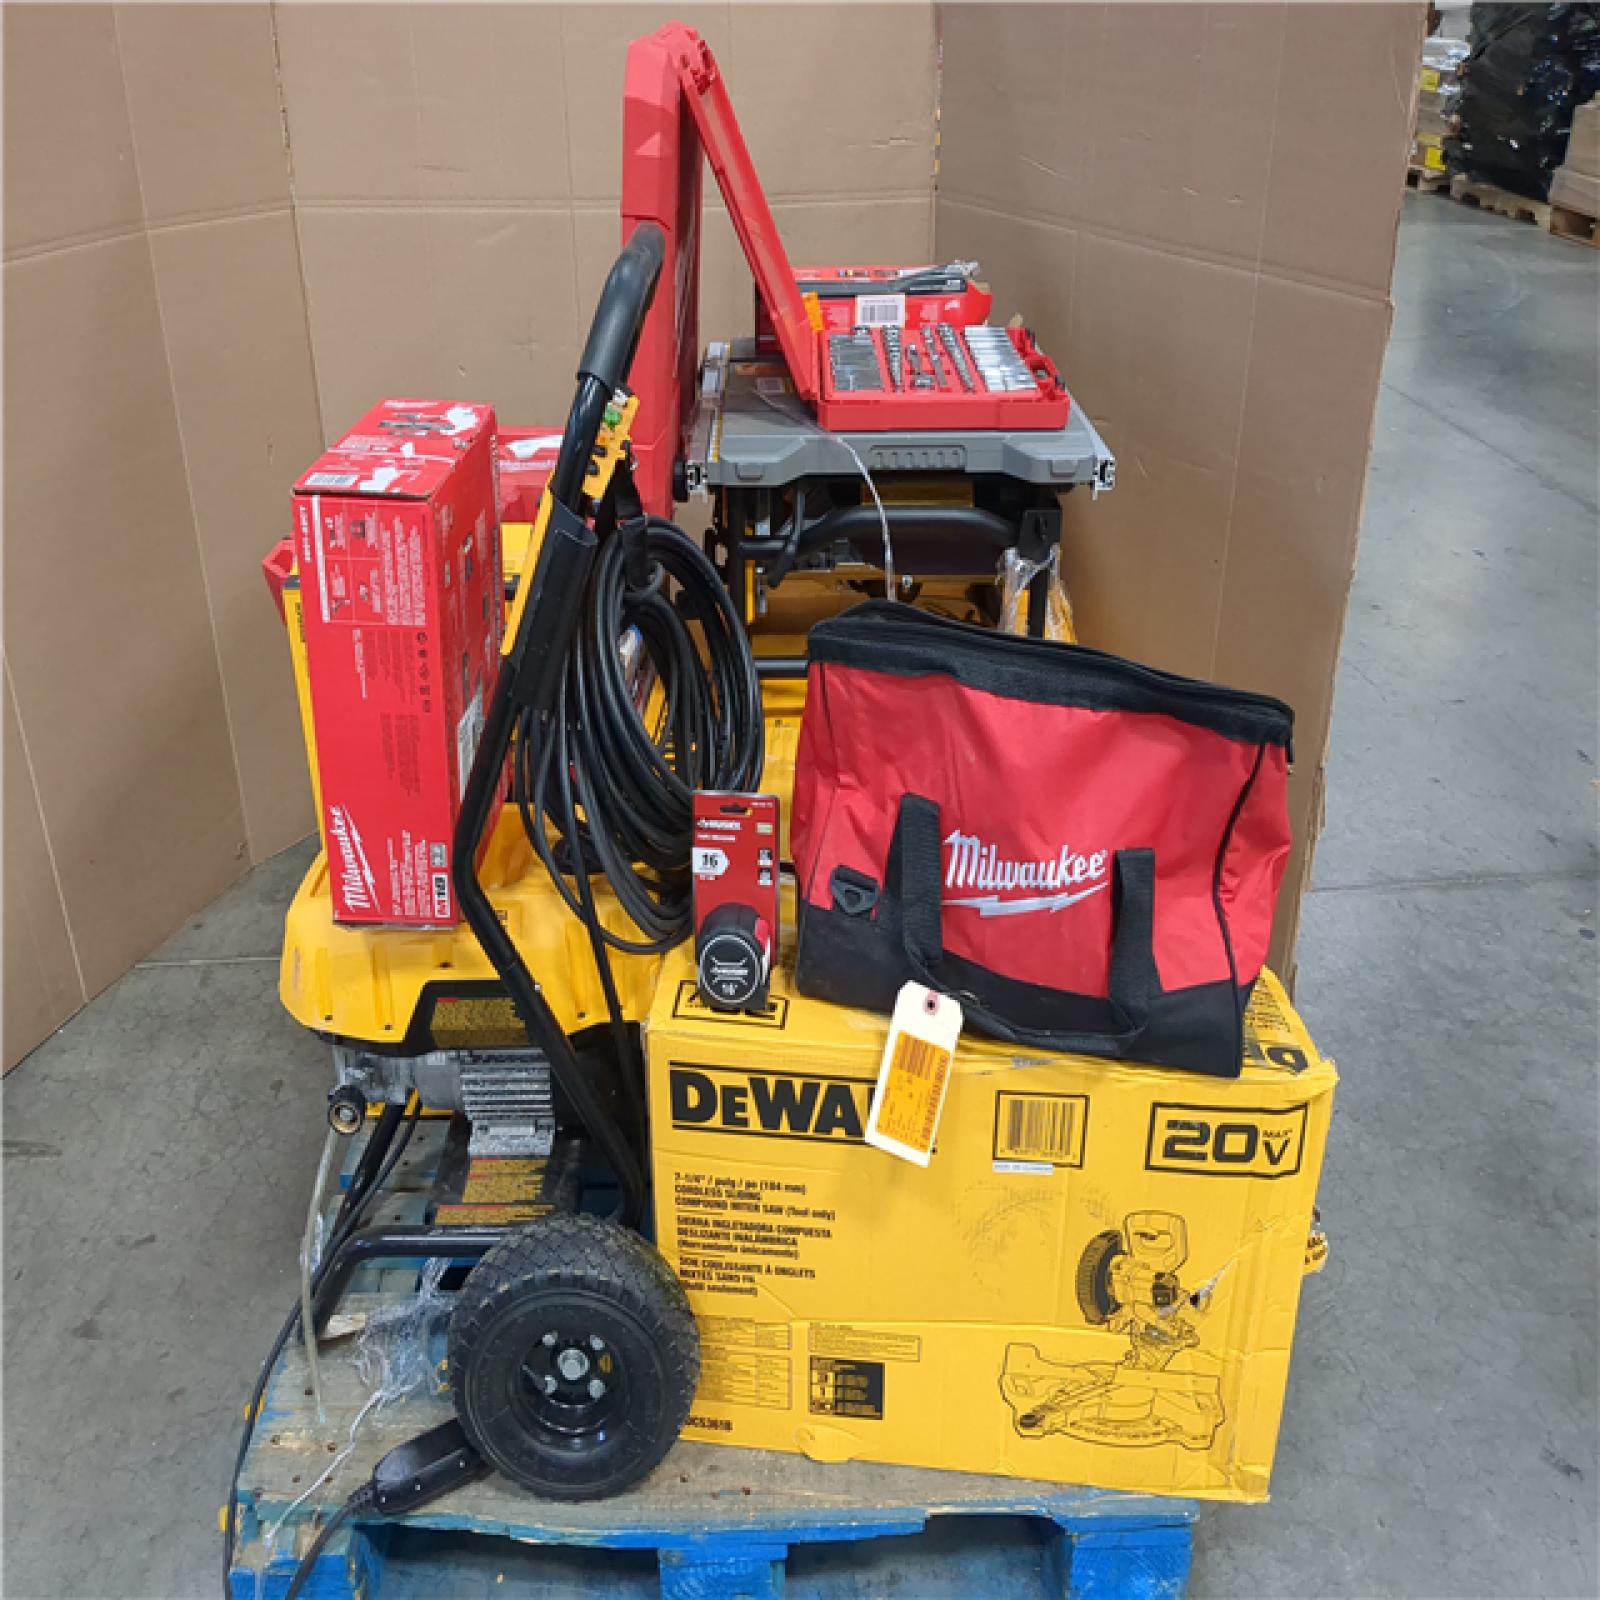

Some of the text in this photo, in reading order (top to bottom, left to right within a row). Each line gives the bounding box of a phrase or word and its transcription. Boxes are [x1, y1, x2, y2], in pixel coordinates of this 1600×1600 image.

[329, 804, 371, 912] Milwaukee
[701, 853, 719, 869] 16
[943, 829, 1108, 892] Milwaukee
[669, 1069, 876, 1137] DEWA
